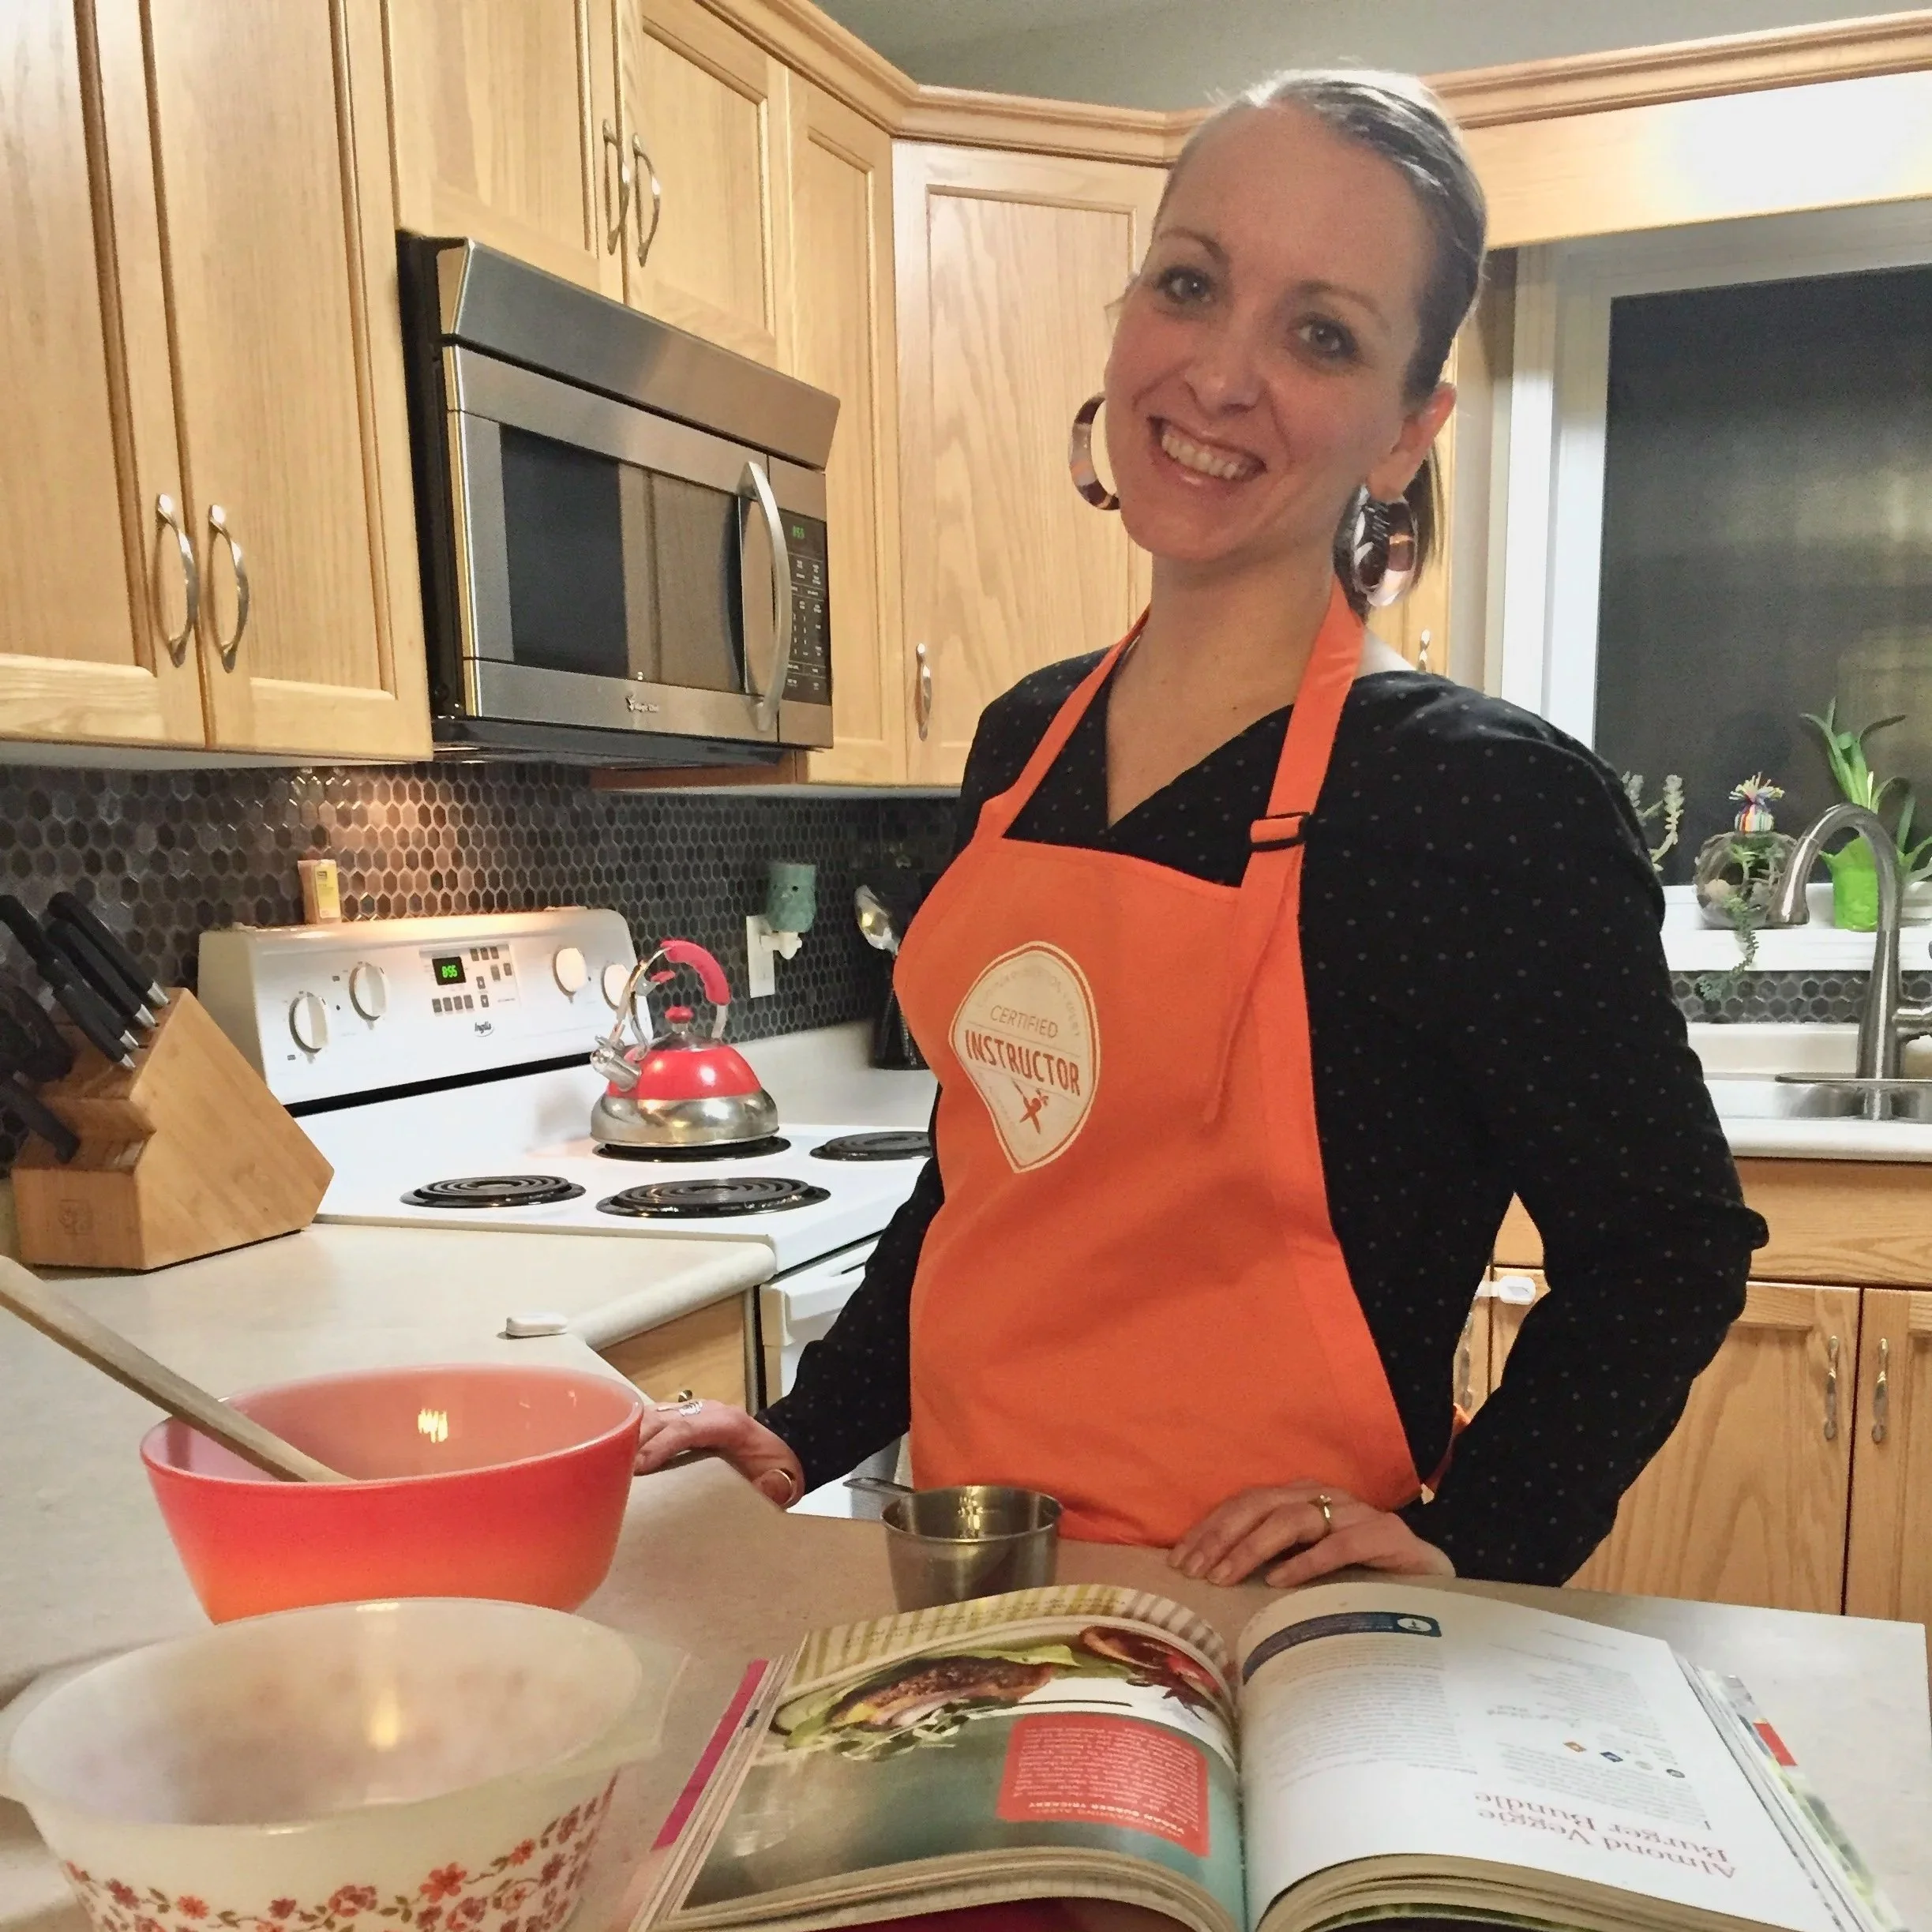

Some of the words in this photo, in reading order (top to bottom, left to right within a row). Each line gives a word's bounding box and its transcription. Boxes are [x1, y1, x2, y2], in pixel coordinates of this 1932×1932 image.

[990, 1004, 1058, 1039] CERTIFIED
[965, 1029, 1081, 1096] INSTRUCTOR
[1474, 1791, 1596, 1831] Bundle
[1477, 1809, 1592, 1845] Veggie
[1604, 1836, 1736, 1878] Almond
[1608, 1823, 1728, 1863] Burger
